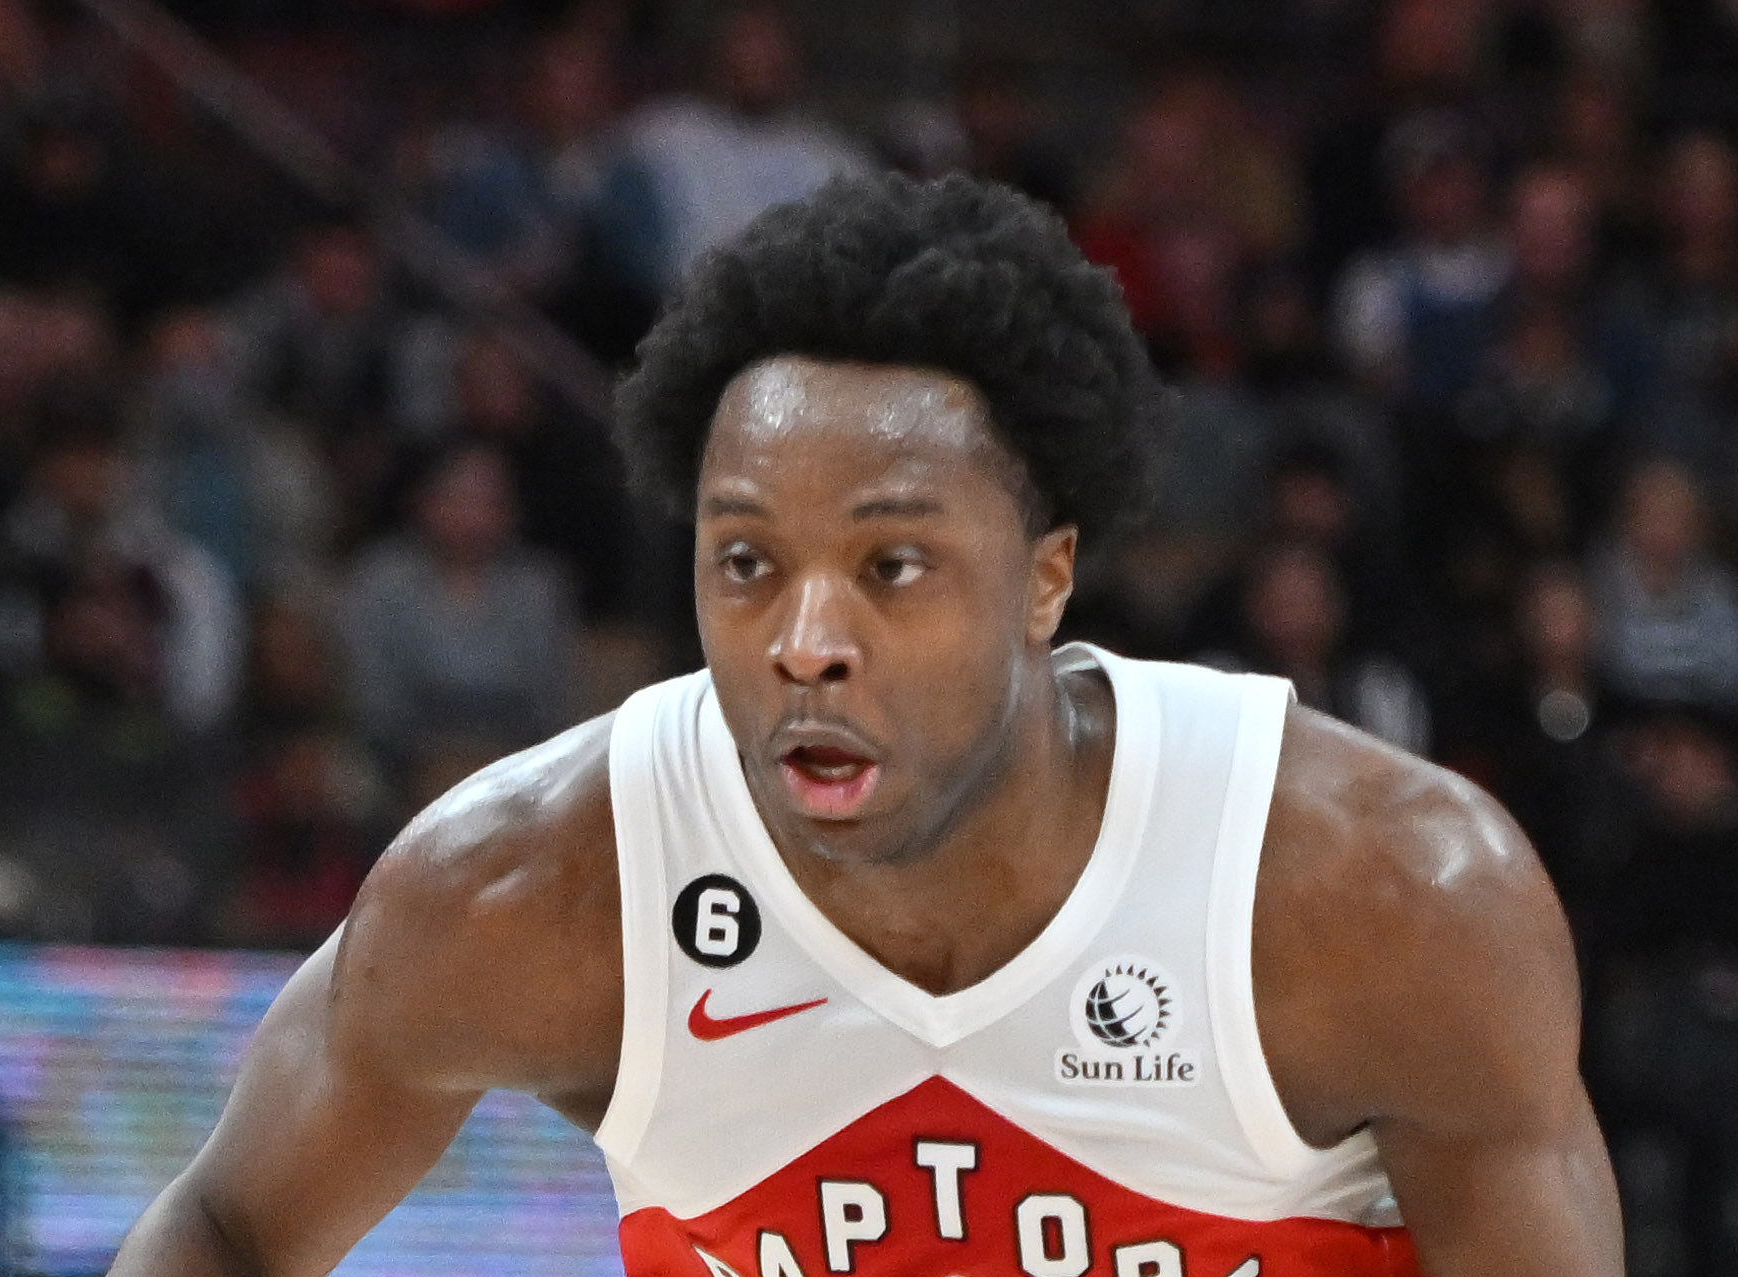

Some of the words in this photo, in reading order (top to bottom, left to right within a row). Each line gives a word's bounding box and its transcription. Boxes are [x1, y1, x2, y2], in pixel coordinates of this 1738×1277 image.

[694, 887, 742, 957] 6
[1060, 1053, 1124, 1080] Sun
[1133, 1052, 1195, 1082] Life
